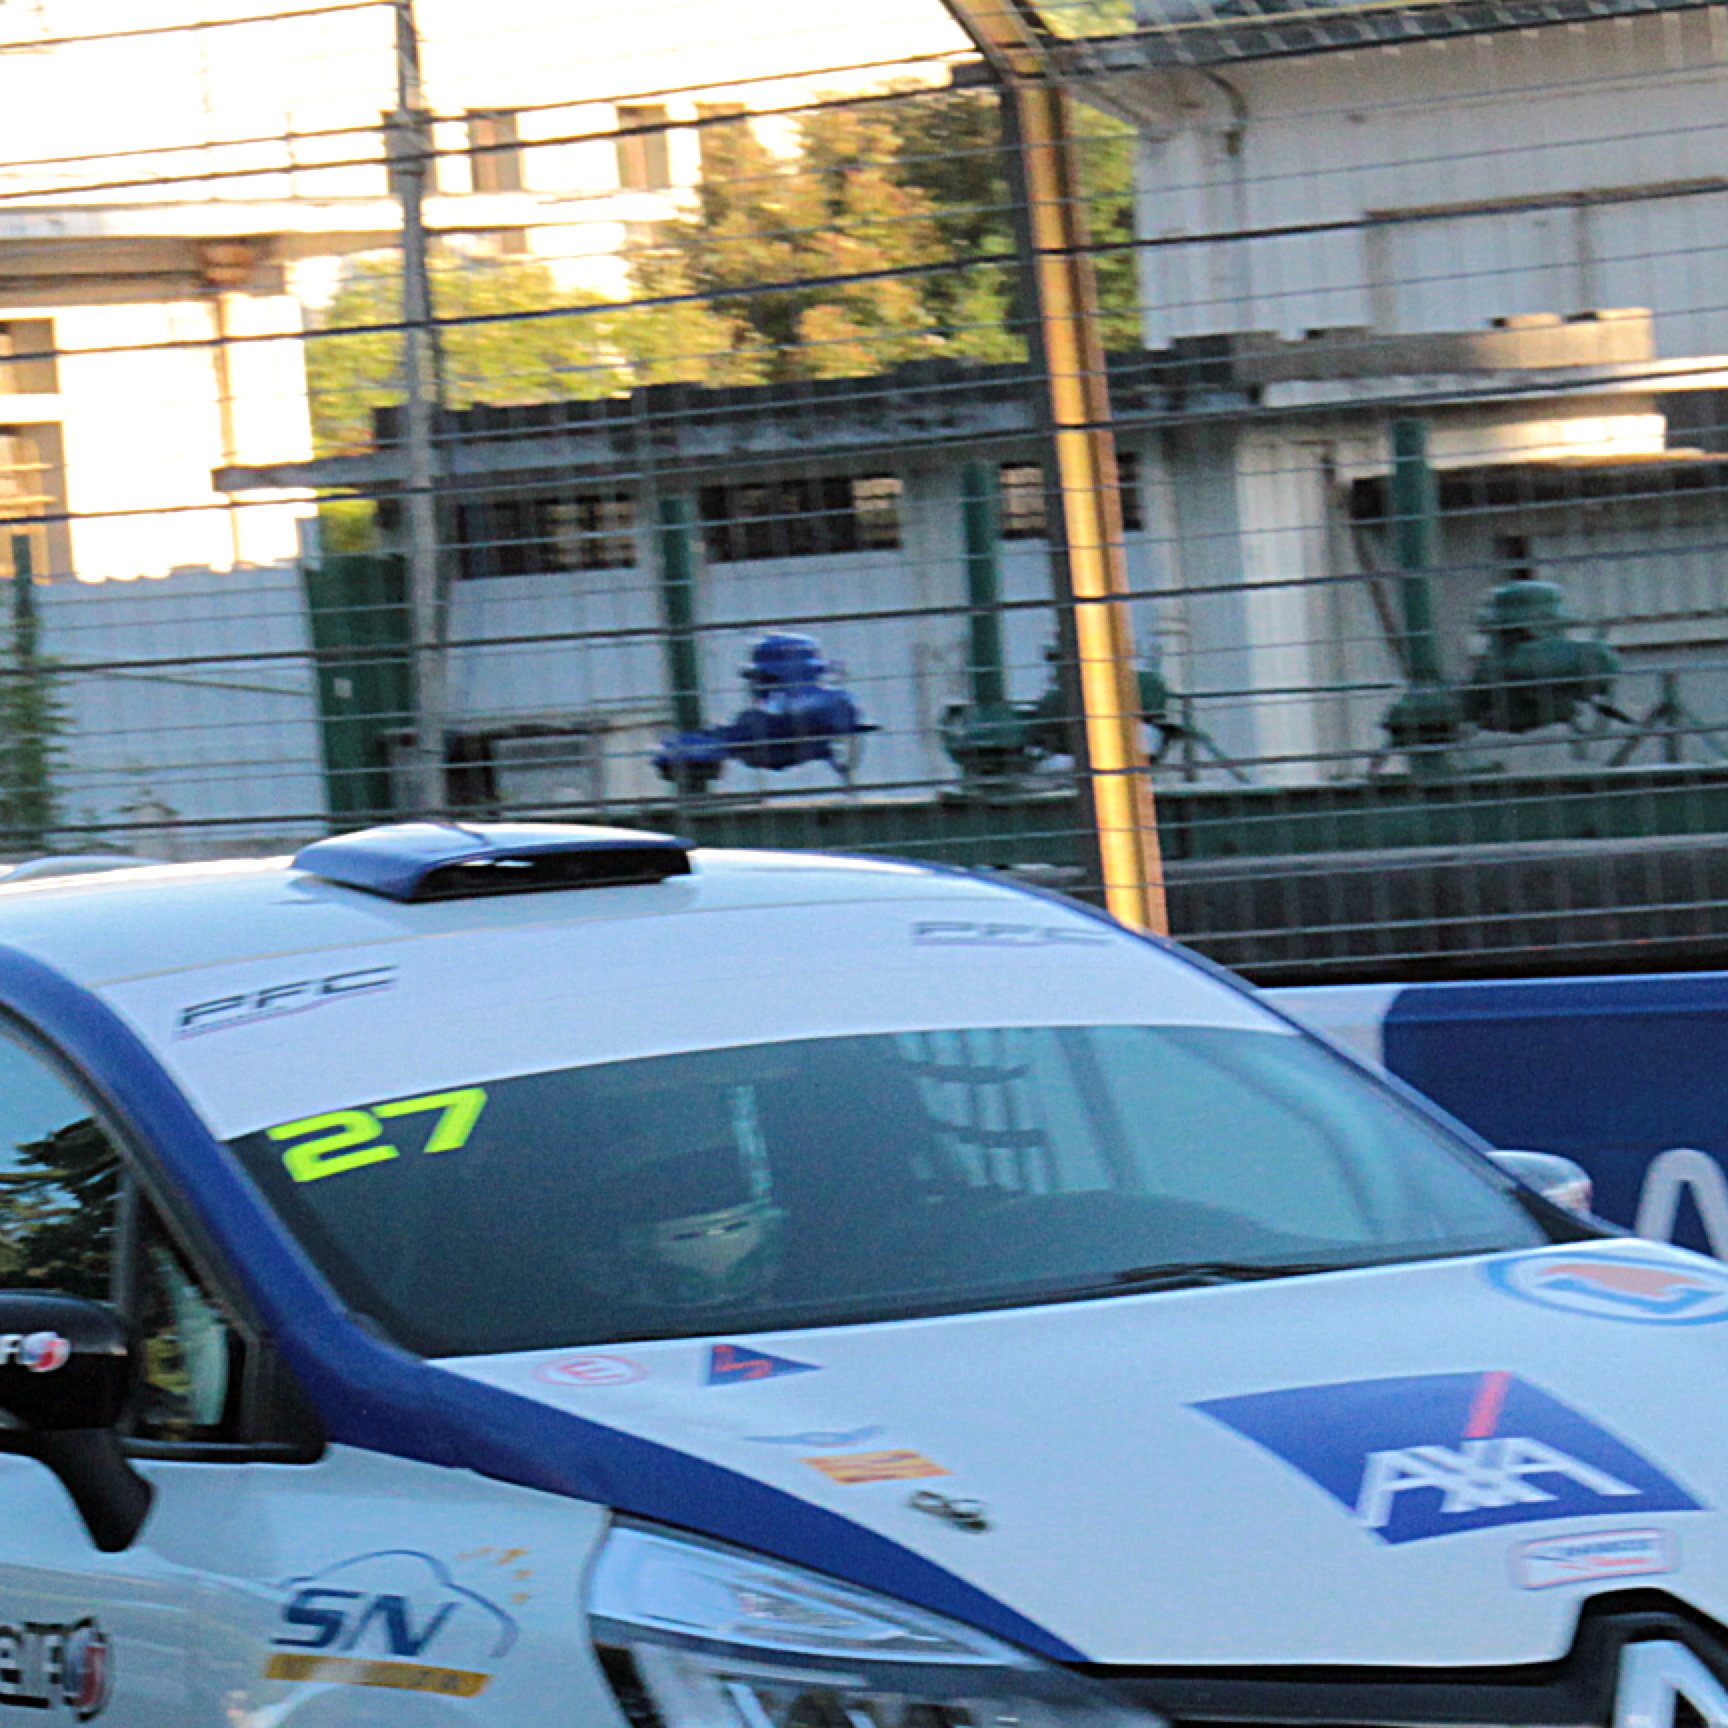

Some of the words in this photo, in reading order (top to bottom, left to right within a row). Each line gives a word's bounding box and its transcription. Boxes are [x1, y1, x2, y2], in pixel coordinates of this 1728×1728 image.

[177, 965, 399, 1026] PFC
[267, 1086, 489, 1184] 27
[1357, 1436, 1643, 1527] AXA
